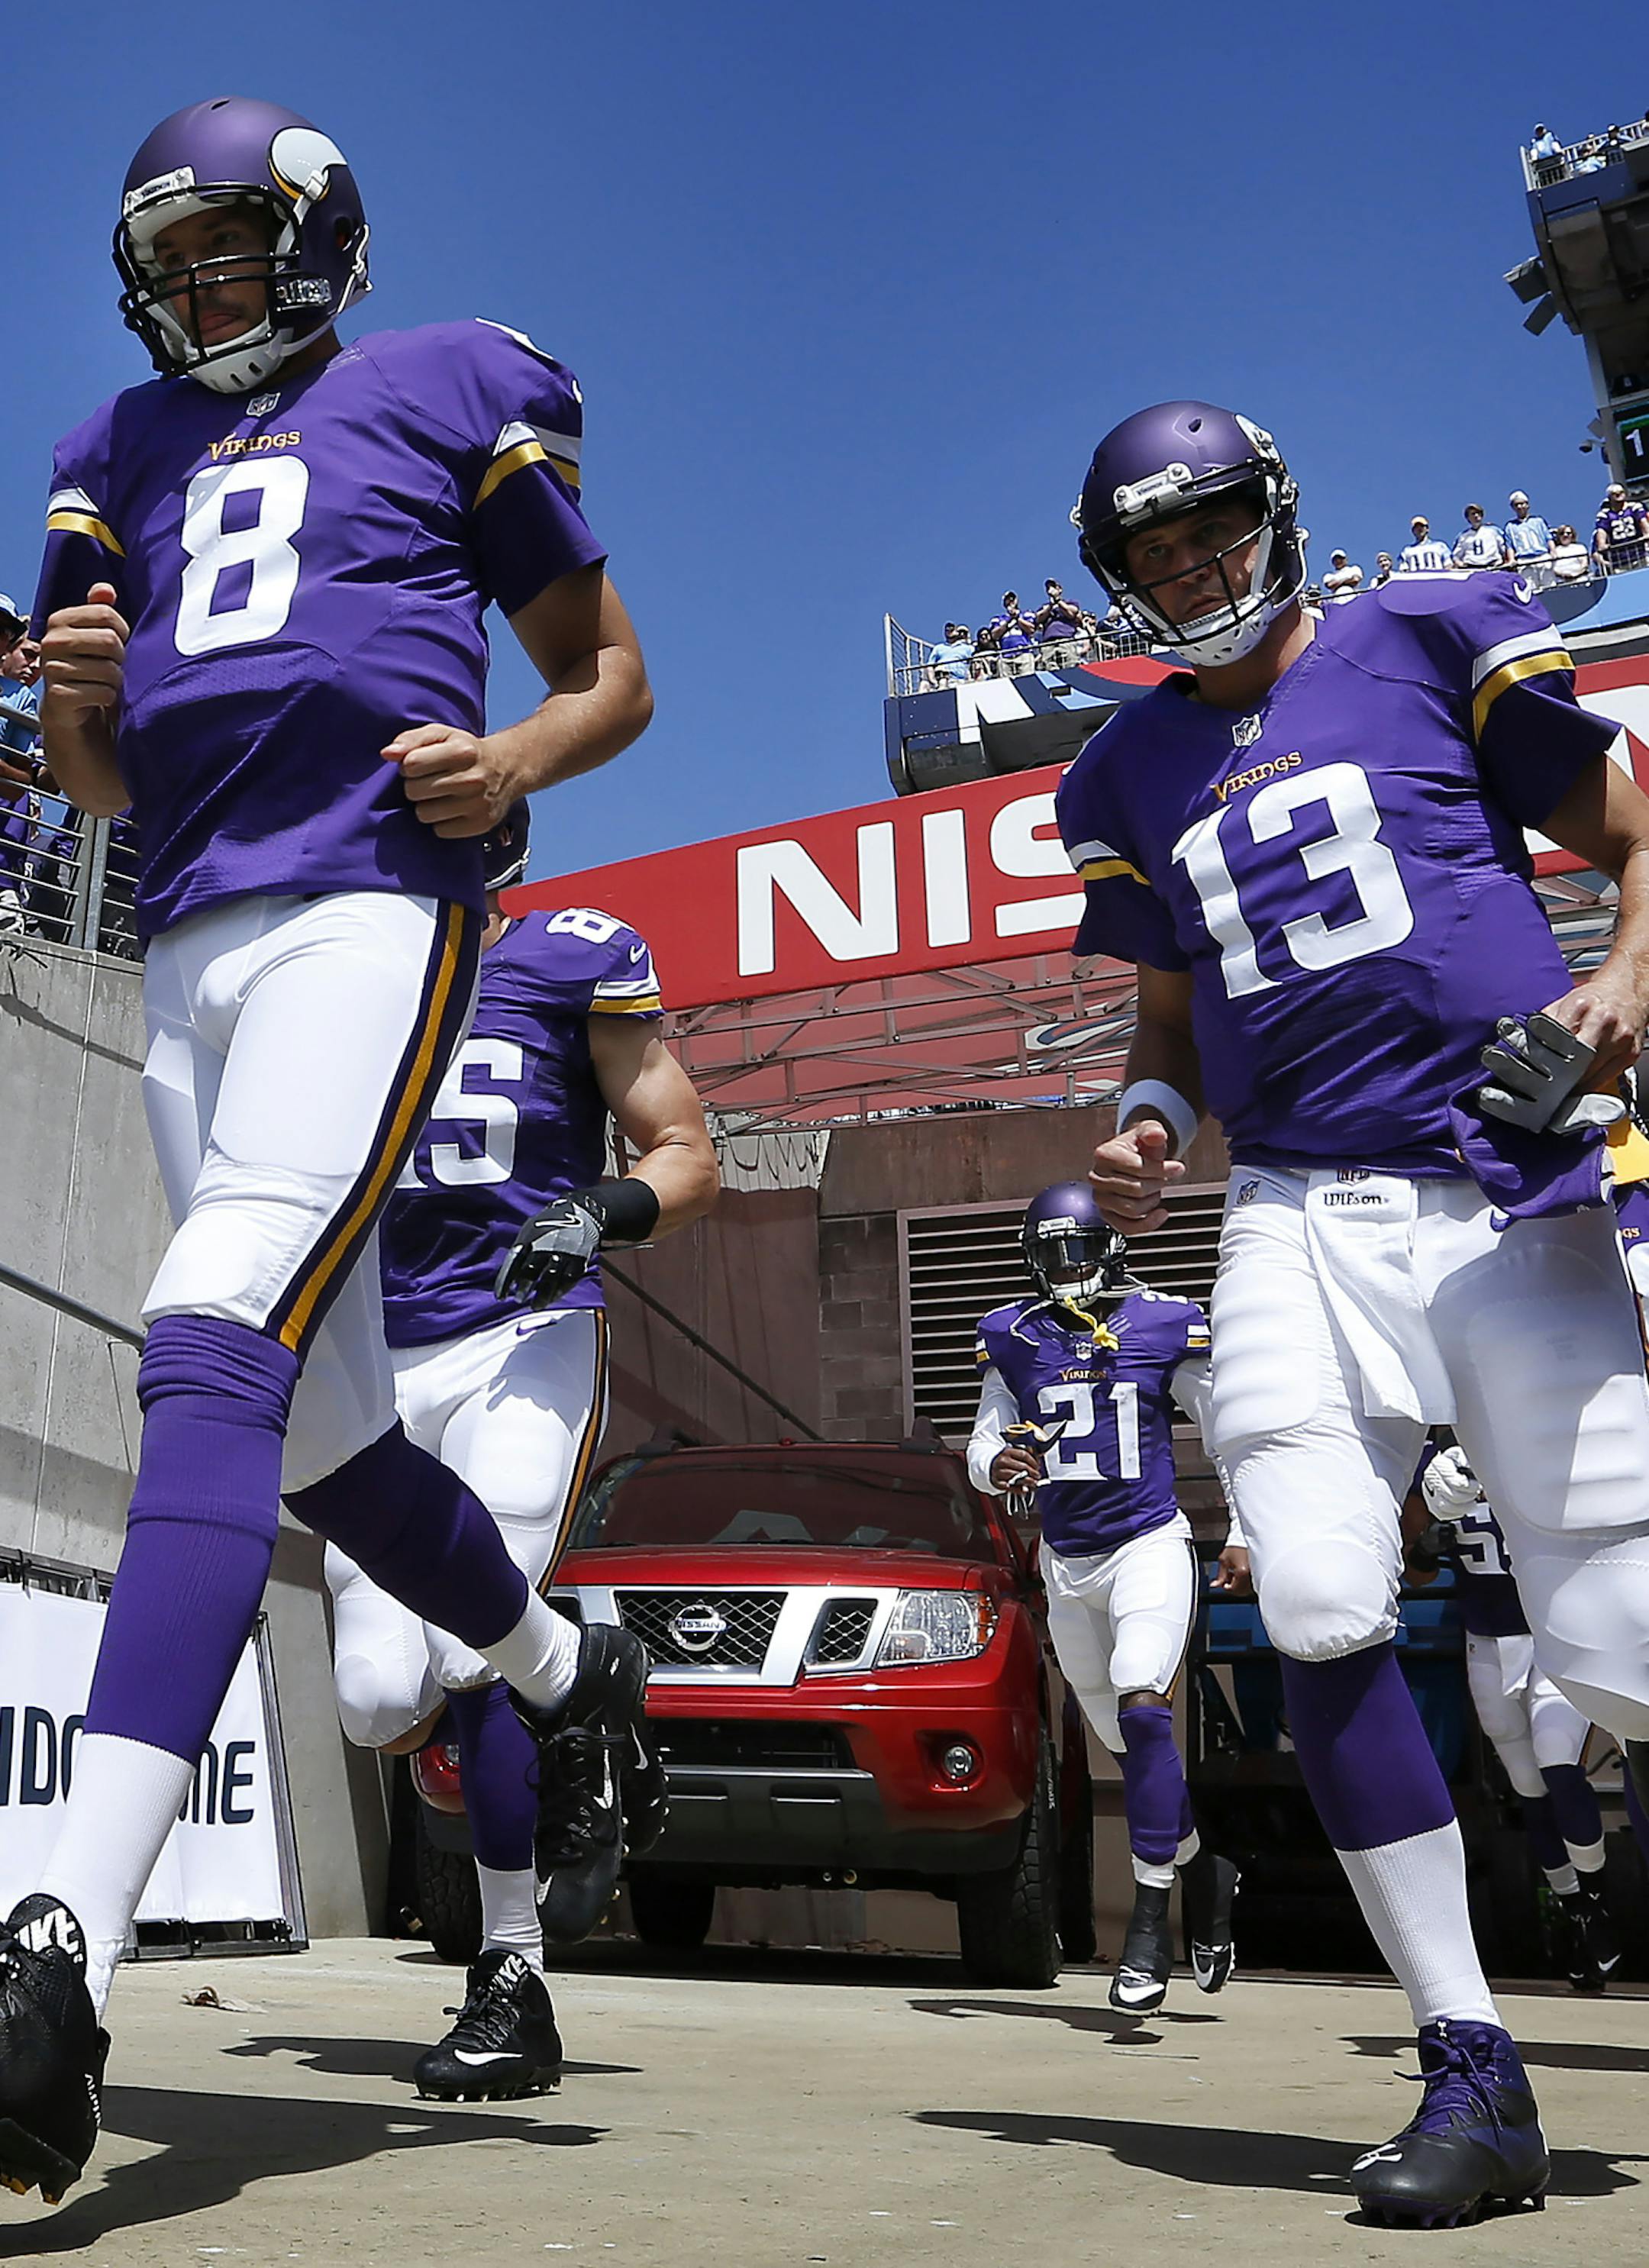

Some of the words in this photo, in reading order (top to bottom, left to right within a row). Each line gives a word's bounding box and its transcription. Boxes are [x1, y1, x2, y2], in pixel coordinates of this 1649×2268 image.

[208, 431, 301, 461] VIKINGS
[175, 454, 310, 657] 8
[1209, 750, 1302, 802] VIKINGS
[1171, 761, 1415, 1000] 13
[545, 907, 635, 944] 8
[1324, 1192, 1383, 1206] Wilson
[1037, 1381, 1141, 1481] 21
